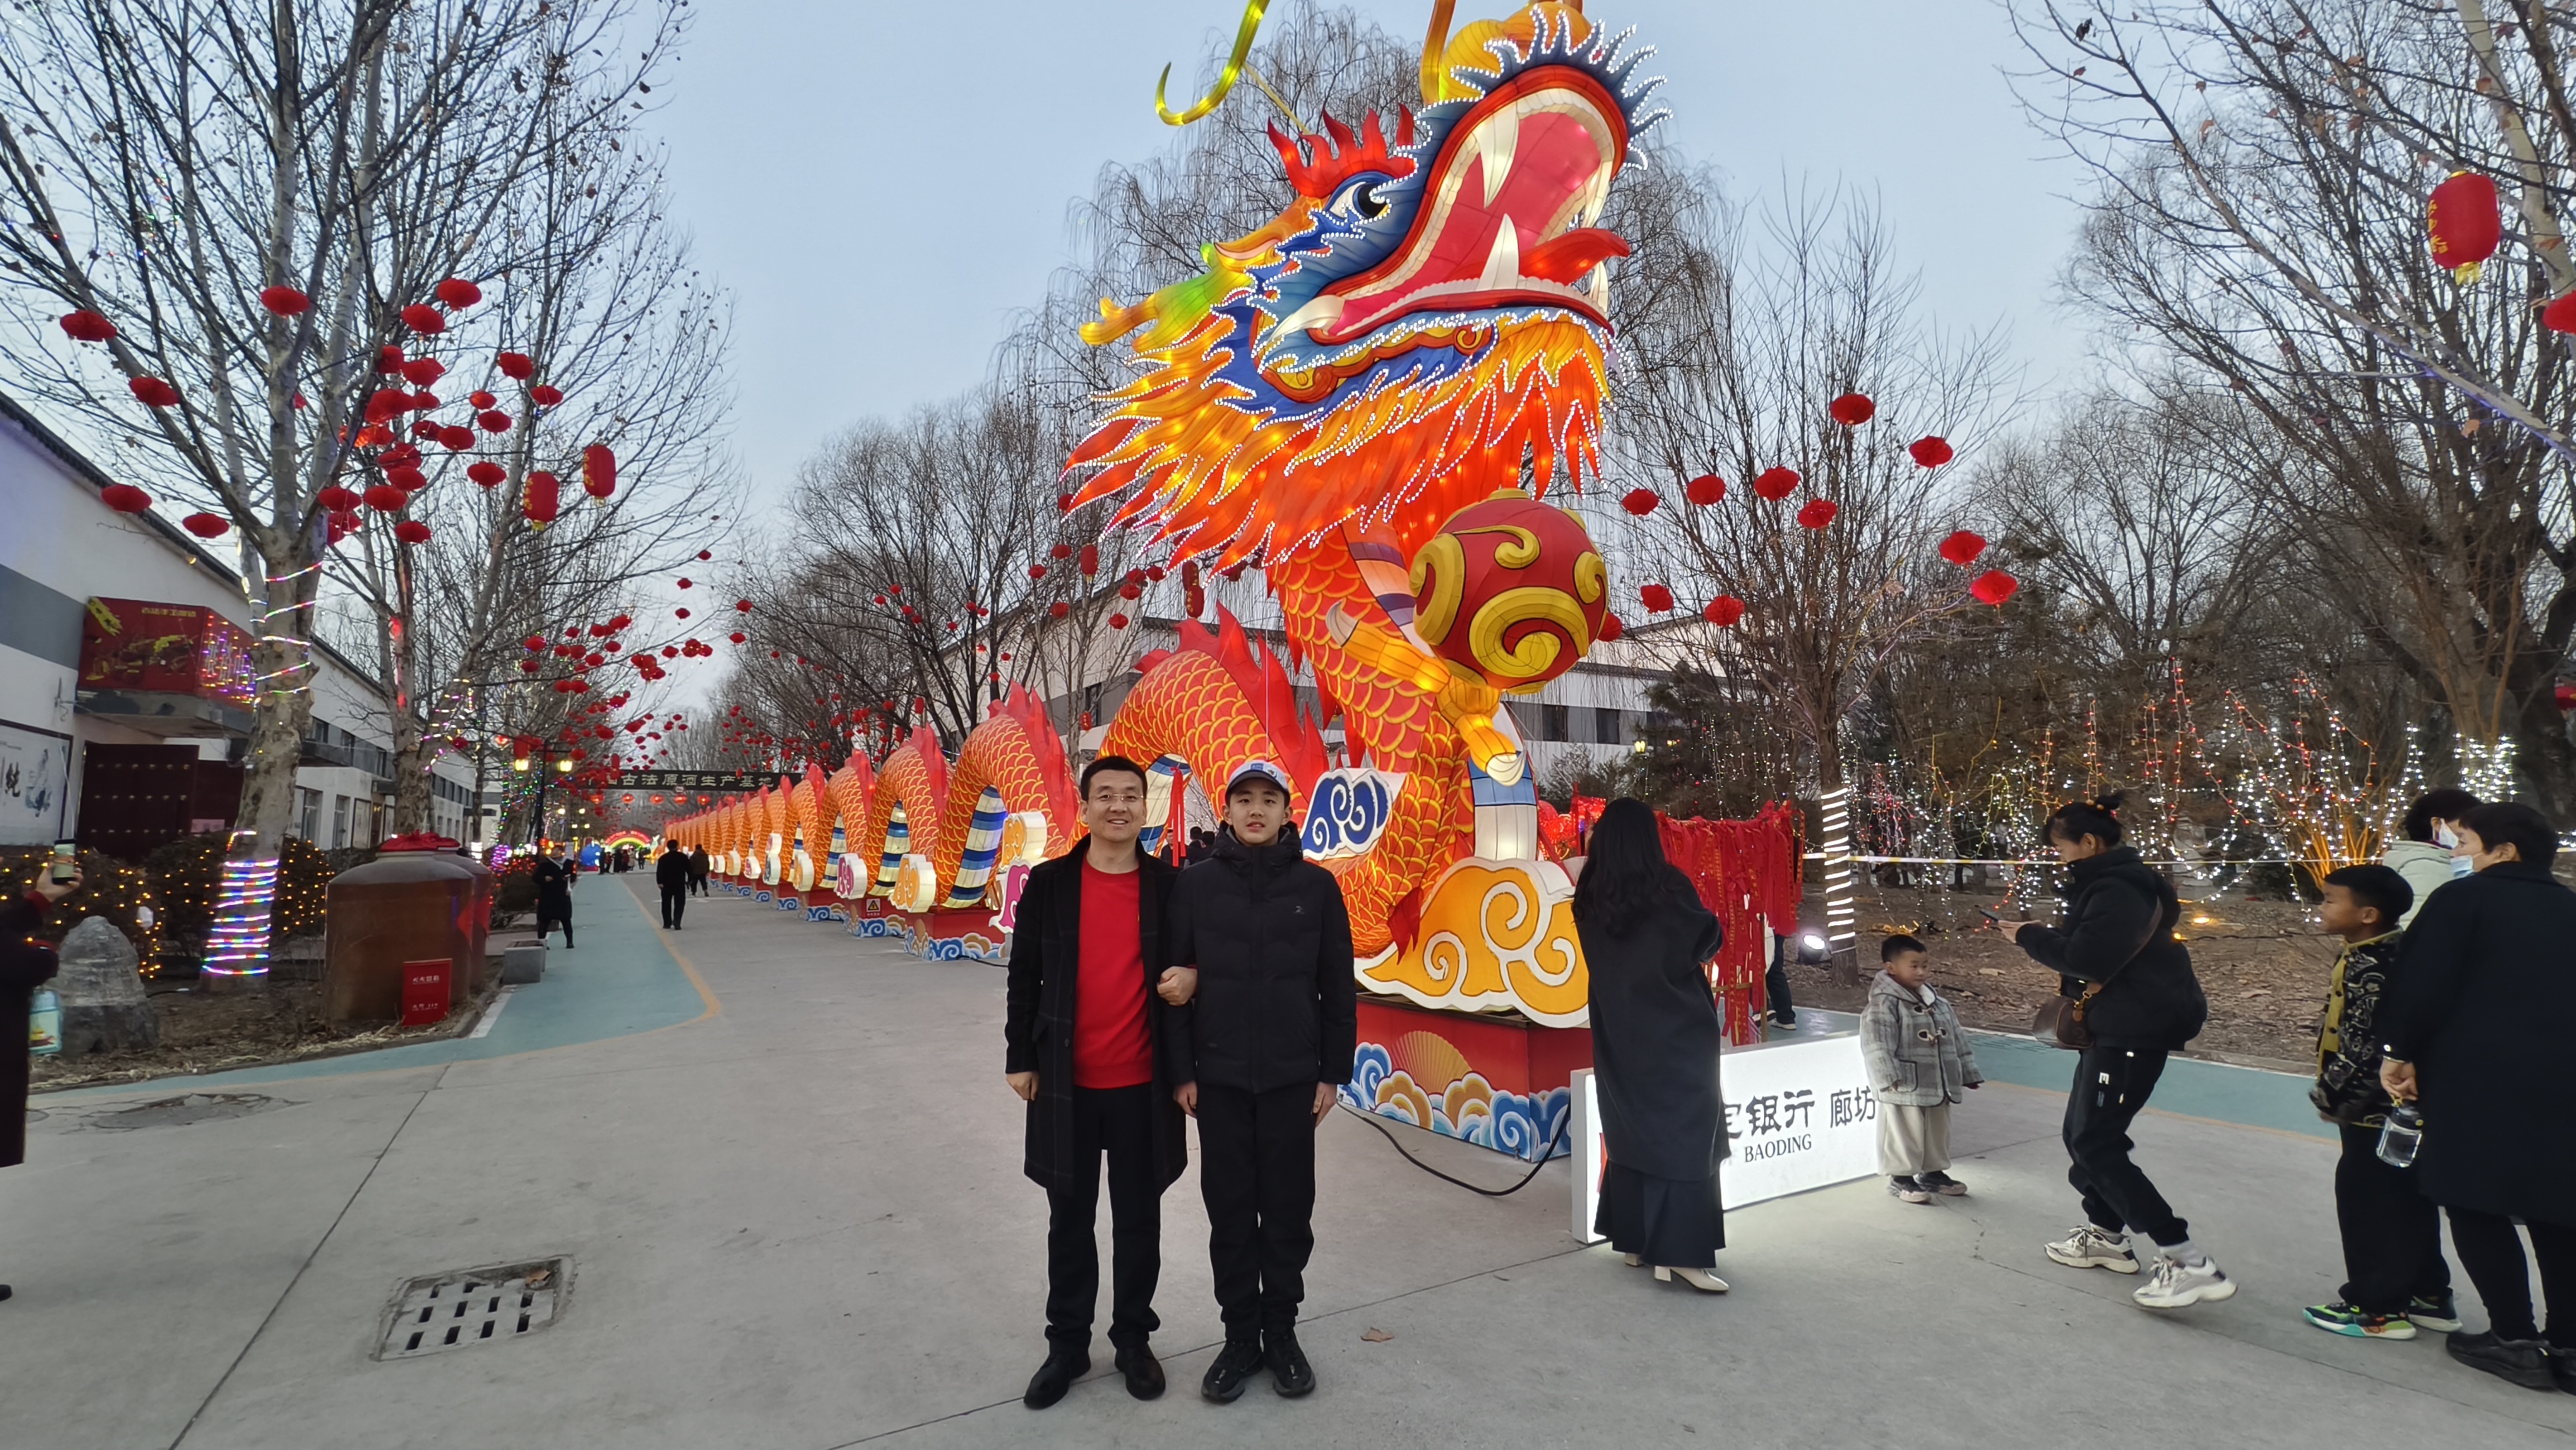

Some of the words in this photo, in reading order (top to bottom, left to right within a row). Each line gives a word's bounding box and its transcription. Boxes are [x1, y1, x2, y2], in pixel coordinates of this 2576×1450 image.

[588, 772, 774, 788] 古法原酒生产基地
[1830, 1086, 1876, 1129] 廊坊
[1744, 1134, 1812, 1163] BAODING
